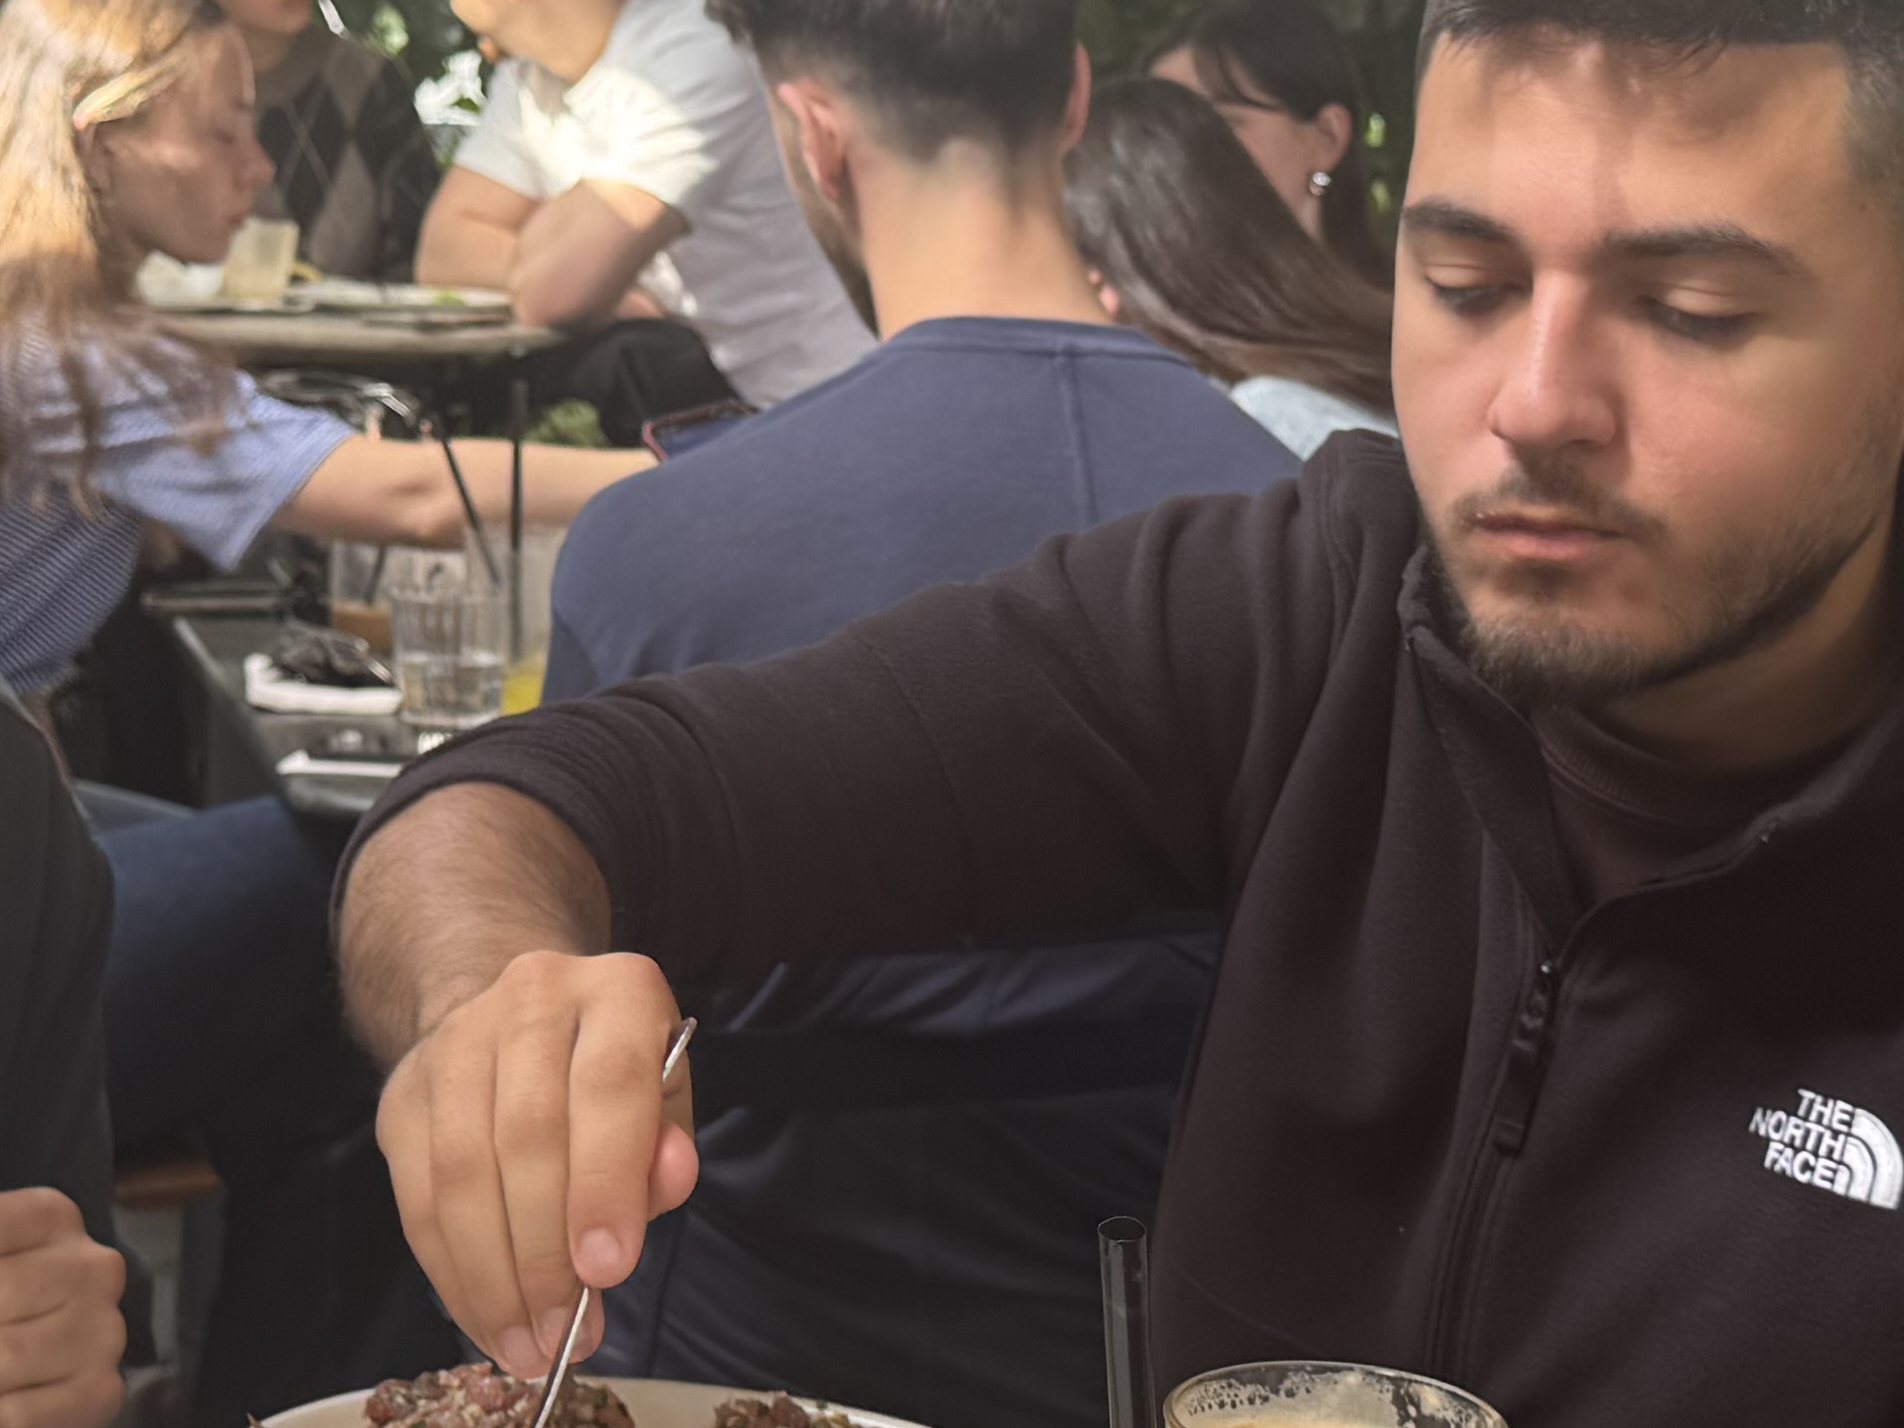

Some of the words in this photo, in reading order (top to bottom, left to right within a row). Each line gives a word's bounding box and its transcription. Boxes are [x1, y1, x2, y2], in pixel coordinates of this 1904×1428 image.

[1748, 1107, 1846, 1161] NORTH
[1797, 1088, 1853, 1133] THE
[1763, 1140, 1839, 1191] FACE
